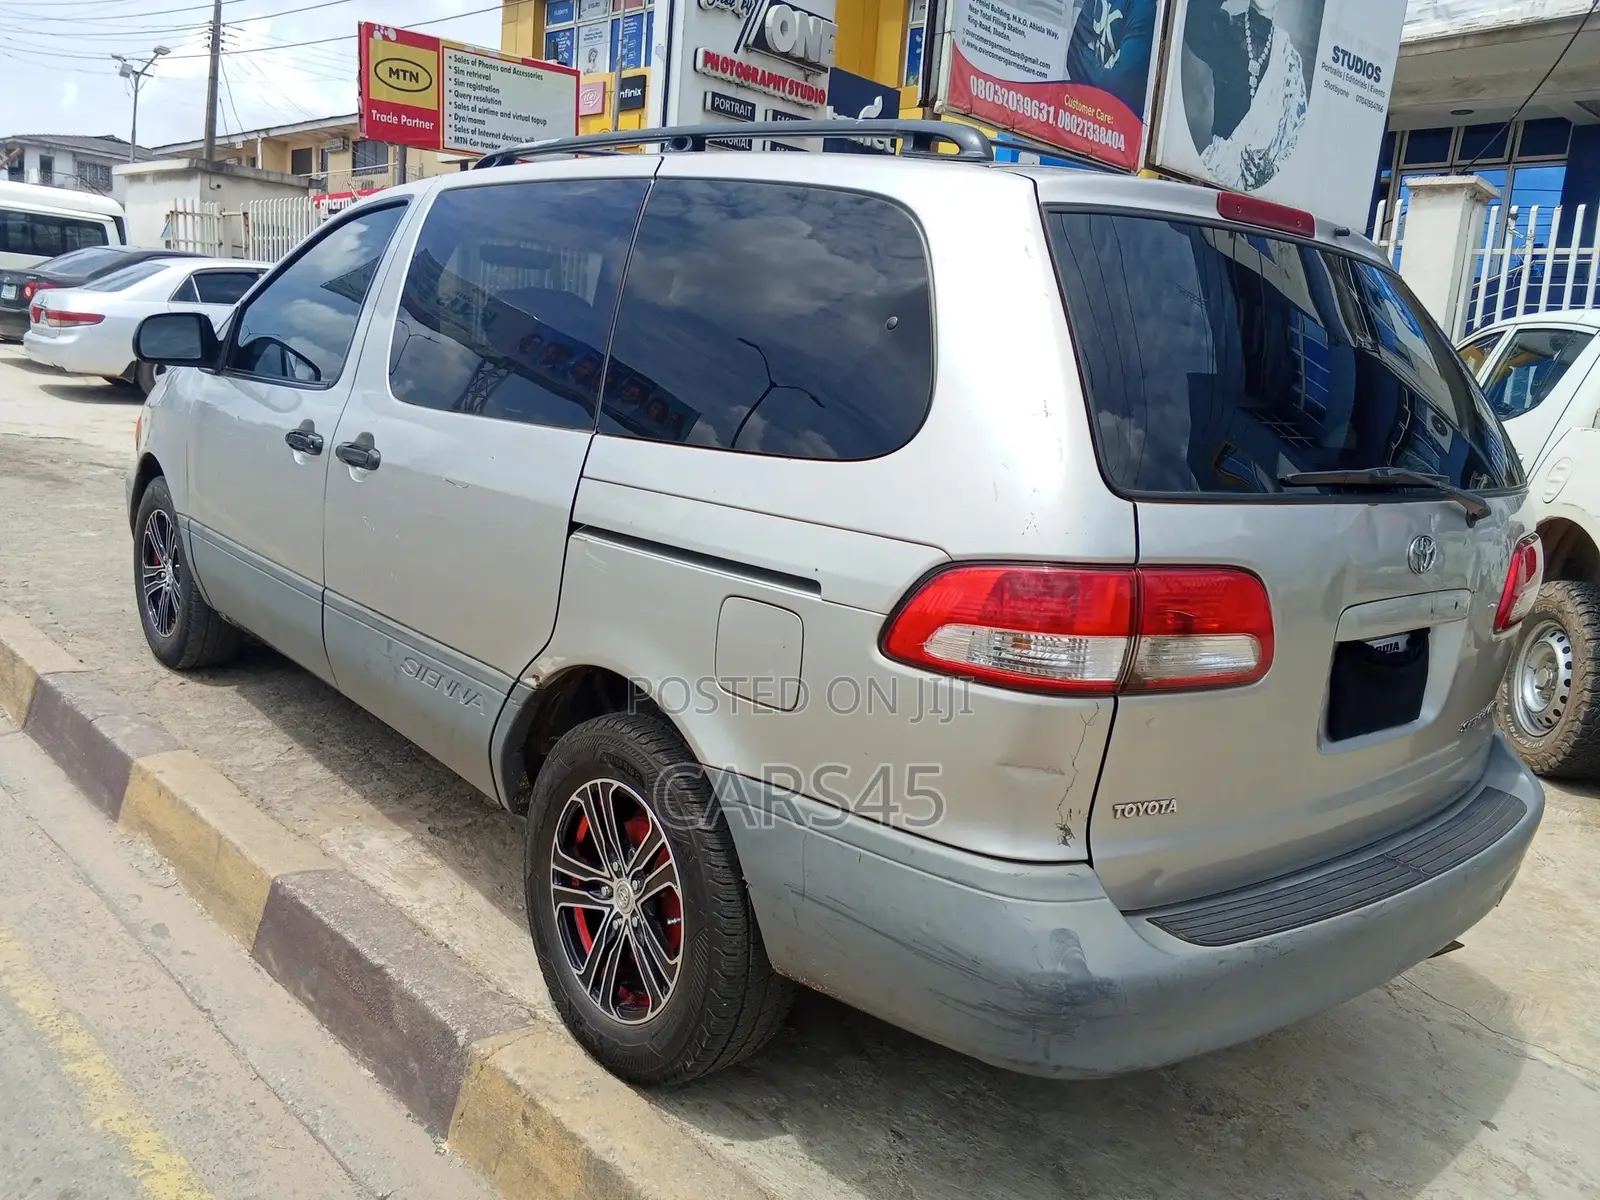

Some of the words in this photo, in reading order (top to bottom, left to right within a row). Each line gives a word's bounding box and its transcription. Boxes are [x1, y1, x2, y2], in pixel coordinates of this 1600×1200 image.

[968, 3, 980, 15] Near
[980, 10, 992, 21] Total
[992, 16, 1007, 30] Filling
[1007, 23, 1026, 39] Station,
[990, 4, 1011, 21] Building,
[1029, 21, 1046, 34] Abiola
[765, 4, 838, 68] ONE
[388, 66, 419, 83] MTN
[454, 54, 470, 65] Sales
[471, 58, 477, 67] of
[478, 59, 499, 72] Phones
[500, 65, 511, 74] and
[512, 68, 544, 81] Accessories
[454, 66, 465, 75] Sim
[466, 69, 491, 81] retrieval
[1331, 45, 1382, 84] STUDIOS
[454, 78, 465, 88] Sim
[466, 81, 500, 94] registration
[704, 49, 787, 94] PHOTOGRAPHY
[788, 79, 827, 105] STUDIO
[1321, 61, 1342, 79] Portraits
[1346, 72, 1367, 91] Editorials
[1370, 85, 1386, 98] Events
[454, 89, 472, 102] Query
[473, 95, 502, 106] resolution
[619, 88, 642, 99] nfinix
[454, 101, 470, 112] Sales
[471, 105, 477, 113] of
[478, 107, 498, 117] airtime
[500, 111, 511, 119] and
[512, 113, 530, 122] virtual
[531, 116, 547, 127] topup
[714, 97, 752, 117] PORTRAIT
[1064, 93, 1096, 117] Customer
[1095, 108, 1114, 124] Care:
[371, 109, 398, 124] Trade
[401, 114, 434, 130] Partner
[454, 124, 470, 135] Sales
[471, 127, 477, 135] of
[478, 128, 501, 140] Internet
[454, 136, 468, 145] MTN
[469, 139, 479, 147] Car
[400, 656, 485, 717] SIENNA
[1113, 798, 1177, 819] TOYOTA
